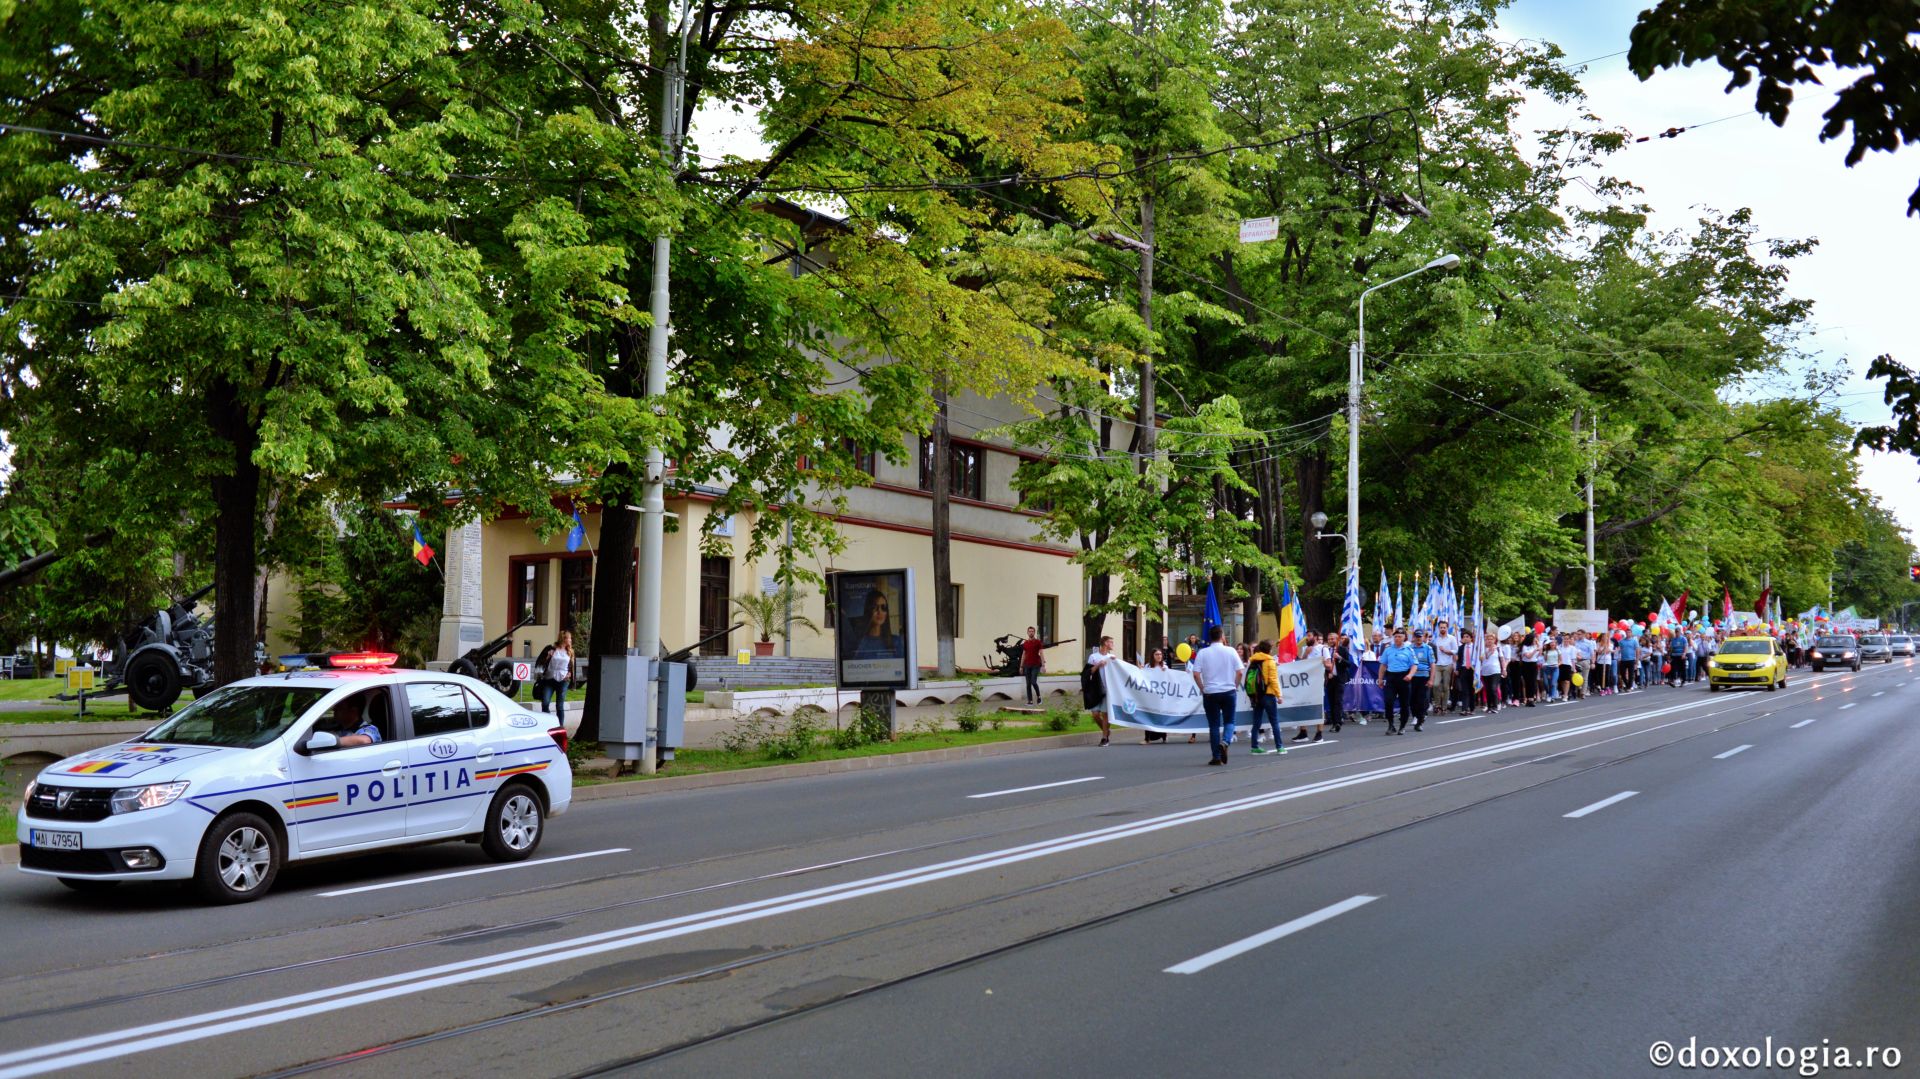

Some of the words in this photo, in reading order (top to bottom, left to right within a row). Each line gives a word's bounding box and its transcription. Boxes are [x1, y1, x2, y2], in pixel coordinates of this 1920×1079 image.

[438, 744, 453, 755] 112
[346, 767, 470, 806] POLITIA
[52, 833, 78, 849] 47954
